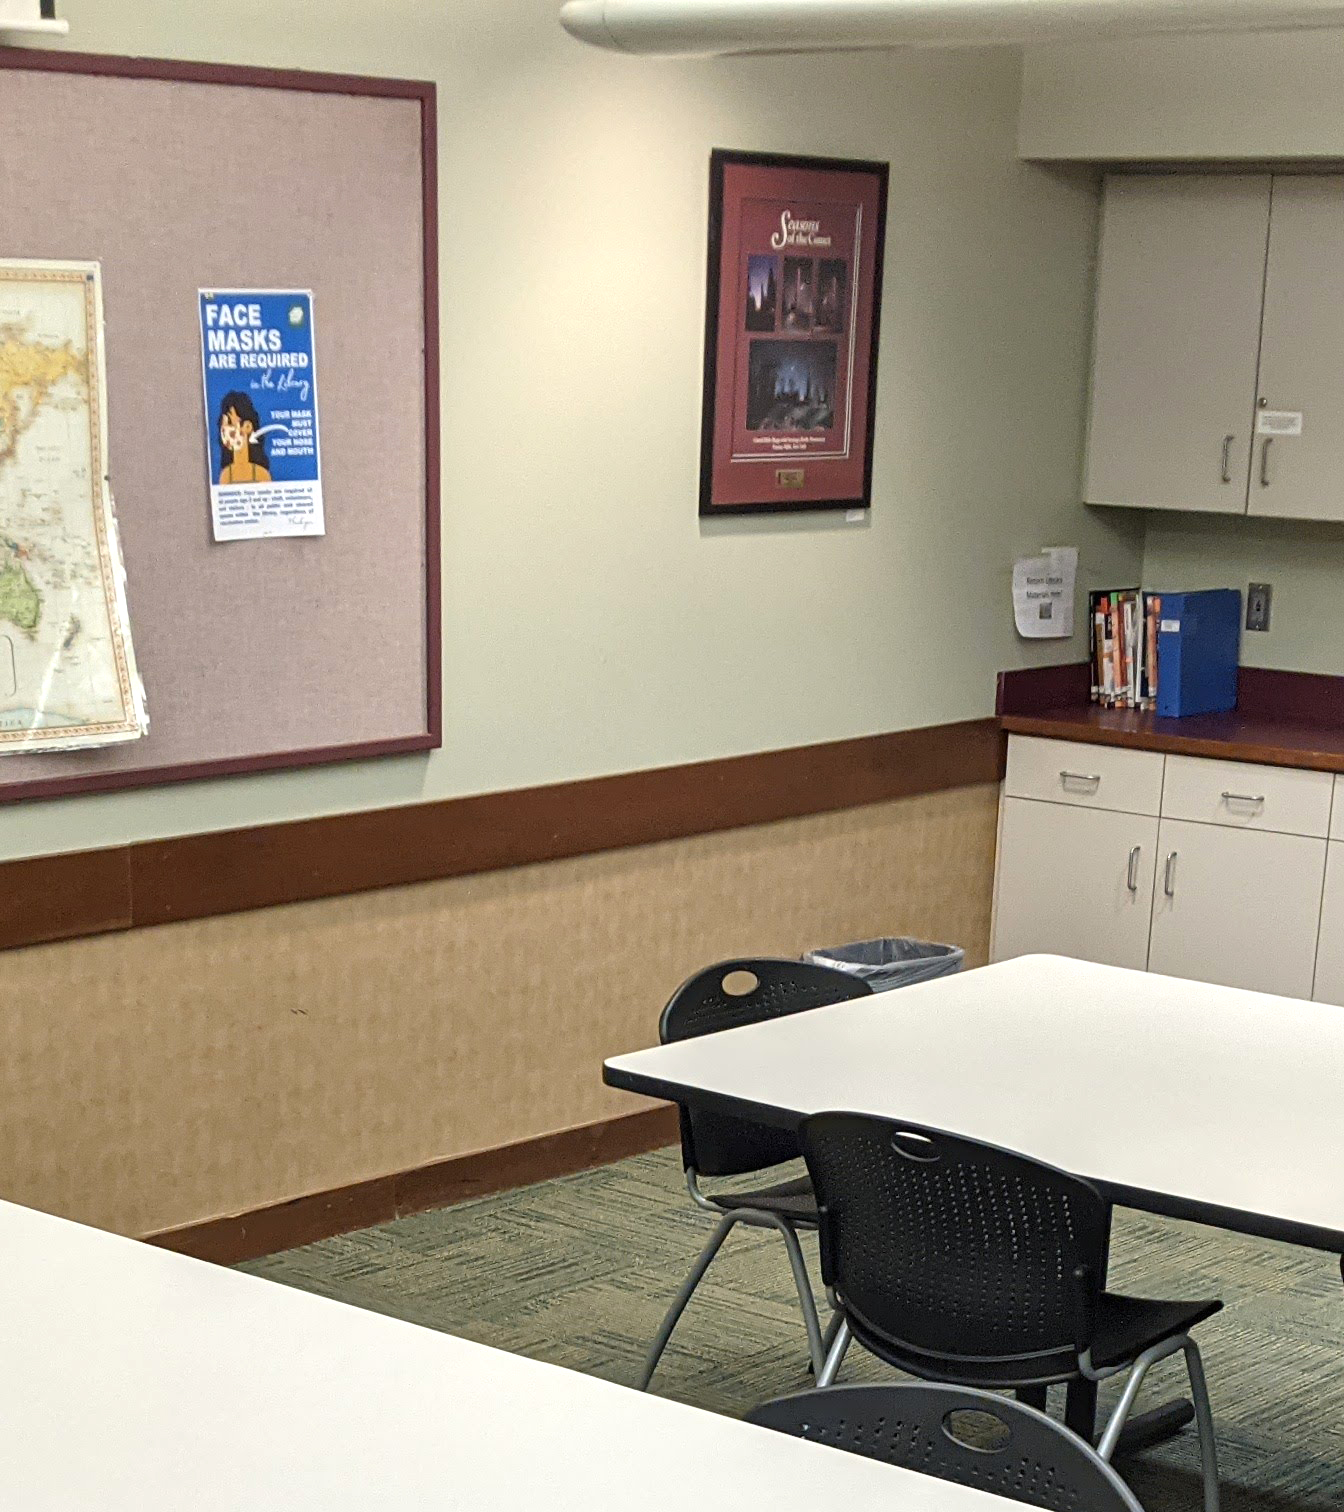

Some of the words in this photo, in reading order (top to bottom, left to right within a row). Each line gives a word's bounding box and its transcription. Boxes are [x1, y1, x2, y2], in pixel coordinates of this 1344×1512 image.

[206, 304, 262, 328] FACE
[208, 329, 282, 352] MASKS
[209, 353, 237, 369] ARE
[239, 352, 309, 369] REQUIRED
[261, 368, 275, 389] the
[270, 410, 290, 420] YOUR
[272, 438, 292, 447] YOUR
